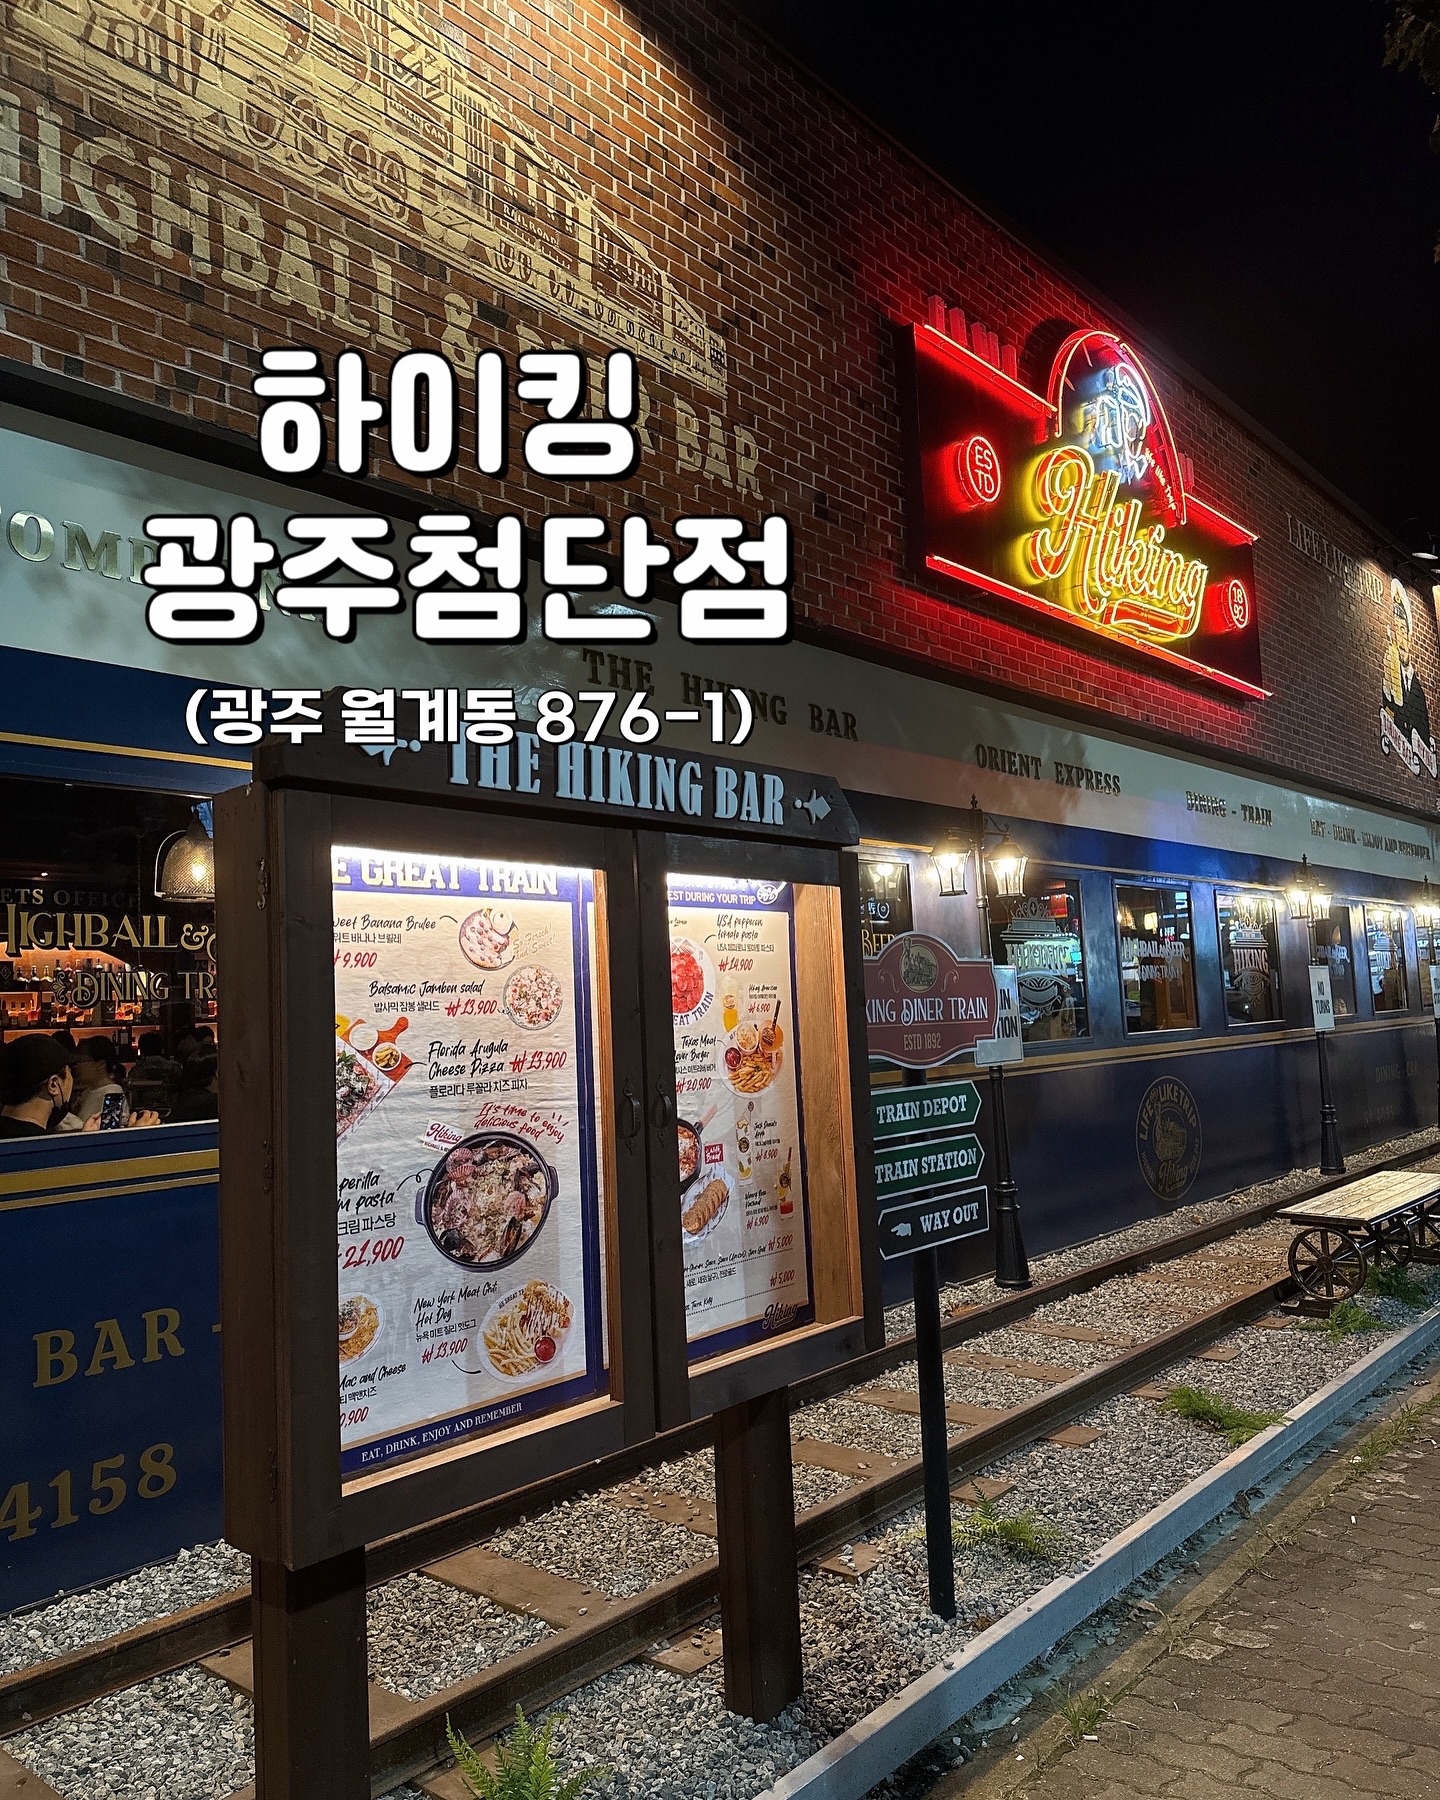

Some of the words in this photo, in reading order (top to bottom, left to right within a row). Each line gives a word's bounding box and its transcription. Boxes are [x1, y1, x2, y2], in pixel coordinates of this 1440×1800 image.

[502, 204, 559, 246] RAILROAD
[674, 397, 763, 500] BAR
[1034, 444, 1209, 638] Hiking
[1286, 512, 1321, 564] LIFE
[582, 648, 654, 696] THE
[808, 703, 858, 742] BAR
[449, 721, 541, 794] THE
[556, 740, 703, 817] HIKING
[713, 765, 785, 826] BAR
[975, 743, 1042, 781] ORIENT
[1054, 761, 1121, 797] EXPRESS
[1185, 790, 1227, 818] DINING
[1240, 803, 1272, 828] TRAIN
[1310, 819, 1326, 837] EAT
[361, 857, 461, 891] GREAT
[473, 865, 559, 896] TRAIN
[685, 891, 715, 903] DURING
[717, 893, 739, 905] YOUR
[739, 894, 757, 905] TRIP
[361, 914, 402, 930] Banana
[740, 930, 759, 941] pasta
[180, 923, 209, 951] &
[351, 932, 376, 944] 바나나
[1232, 948, 1269, 974] HIKING
[71, 971, 170, 1010] DINING
[369, 980, 416, 998] Balsamic
[419, 981, 458, 998] Jambon
[460, 979, 486, 995] salad
[1317, 981, 1325, 996] NO
[374, 1001, 399, 1013] 발사믹
[444, 998, 498, 1018] ₩13,900
[692, 990, 715, 1021] TRAIN
[899, 997, 944, 1027] DINER
[947, 996, 988, 1020] TRAIN
[428, 1039, 466, 1062] Florida
[470, 1039, 509, 1060] Arugula
[681, 1035, 699, 1049] Texas
[903, 1033, 923, 1051] ESTD
[924, 1032, 942, 1050] 1892
[429, 1061, 466, 1081] Cheese
[470, 1058, 505, 1078] Pizza
[509, 1051, 567, 1073] ₩13,900
[429, 1083, 465, 1099] 플로리다
[466, 1081, 492, 1095] 루꼴라
[494, 1080, 511, 1094] 치즈
[511, 1078, 528, 1091] 피자
[877, 1101, 921, 1124] TRAIN
[923, 1094, 968, 1118] DEPOT
[1139, 1098, 1154, 1141] LIFE
[1158, 1083, 1180, 1103] LIKE
[1179, 1089, 1198, 1128] TRIP
[426, 1123, 463, 1144] Hiking
[474, 1114, 518, 1130] delicious
[519, 1123, 545, 1142] food
[503, 1105, 528, 1118] time
[530, 1111, 541, 1123] to
[542, 1119, 565, 1145] enjoy
[875, 1158, 919, 1185] TRAIN
[921, 1147, 977, 1174] STATION
[339, 1171, 380, 1197] perilla
[355, 1190, 395, 1215] pasta
[362, 1212, 397, 1231] 파스탕
[920, 1209, 950, 1234] WAY
[952, 1202, 979, 1224] OUT
[338, 1236, 405, 1270] 21,900
[414, 1297, 435, 1314] New
[436, 1290, 456, 1308] York
[457, 1285, 481, 1303] Meat
[415, 1313, 433, 1331] Hot
[434, 1307, 452, 1324] Dog
[762, 1302, 798, 1330] Hiking
[33, 1307, 185, 1388] BAR
[415, 1330, 430, 1343] 뉴욕
[430, 1327, 445, 1339] 미트
[422, 1338, 468, 1365] ₩13,900
[359, 1367, 379, 1384] and
[378, 1364, 407, 1381] Cheese
[361, 1448, 384, 1463] EAT,
[385, 1435, 421, 1455] DRINK,
[422, 1424, 452, 1444] ENJOY
[453, 1418, 473, 1433] AND
[474, 1402, 523, 1426] REMEMBER
